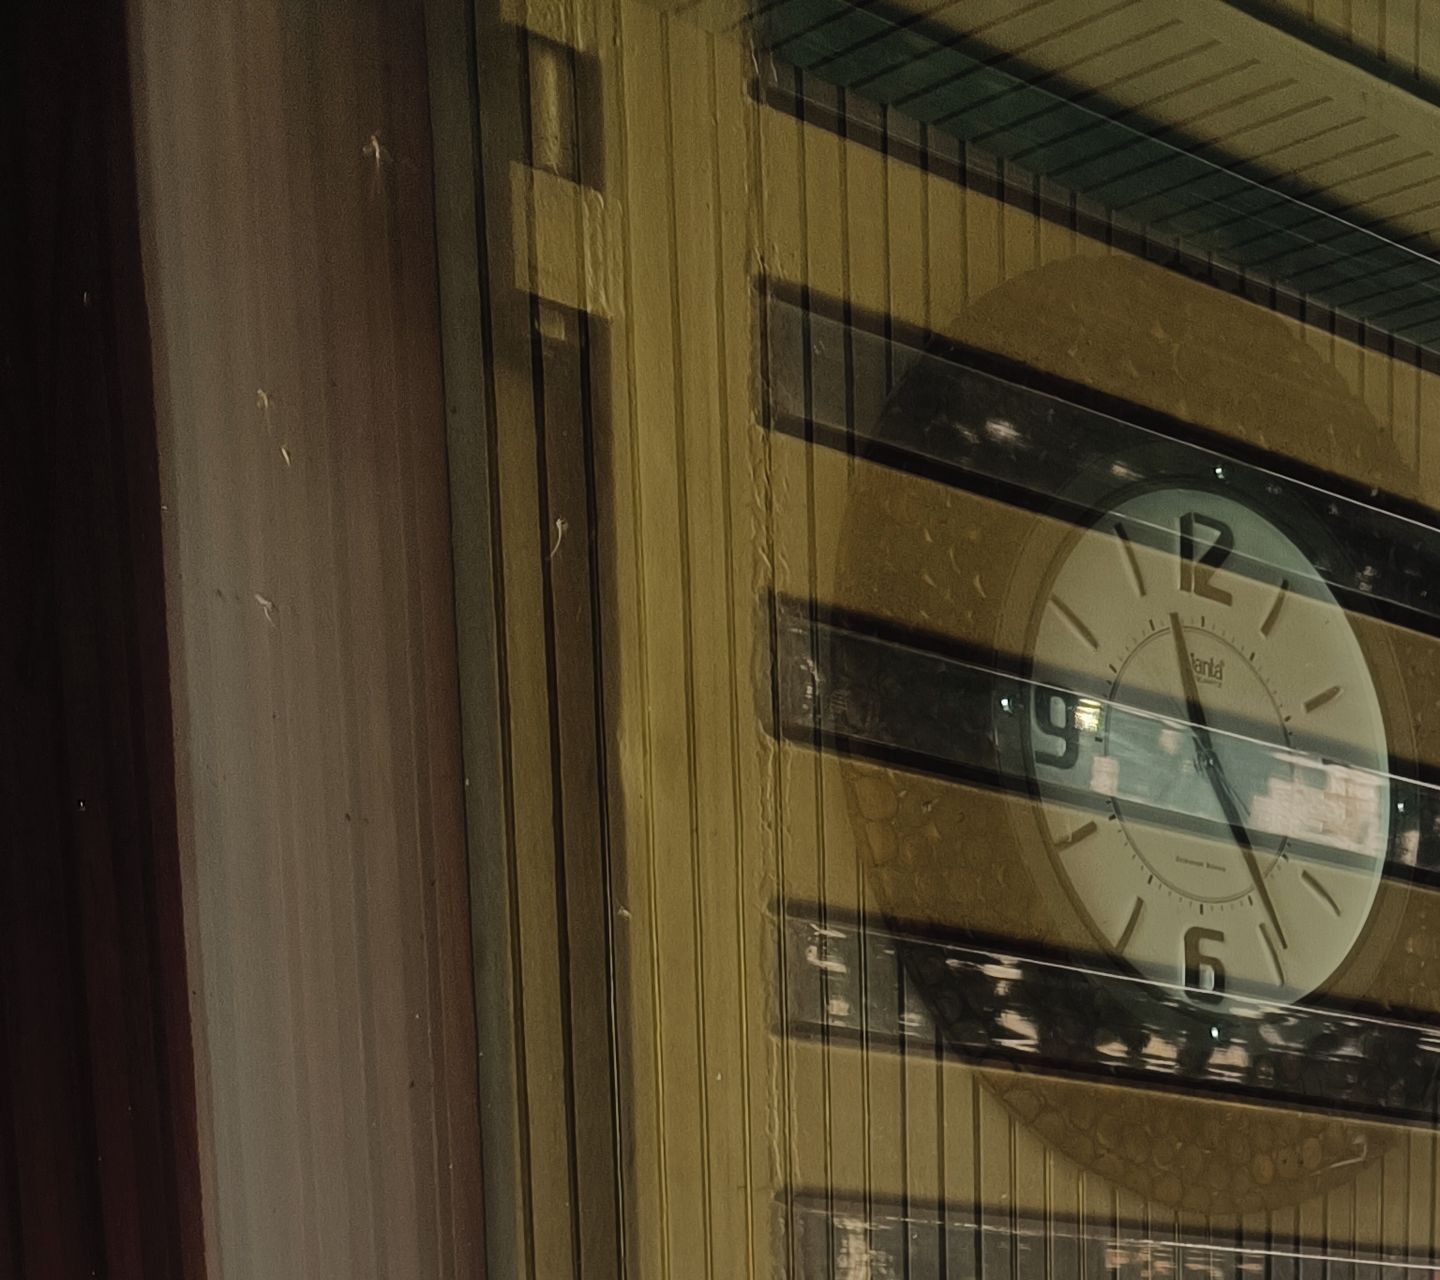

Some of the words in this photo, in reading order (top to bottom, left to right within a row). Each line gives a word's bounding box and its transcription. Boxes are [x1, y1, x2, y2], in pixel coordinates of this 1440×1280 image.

[1179, 511, 1234, 606] 12
[1035, 688, 1080, 770] 9
[1184, 926, 1226, 1005] 6
